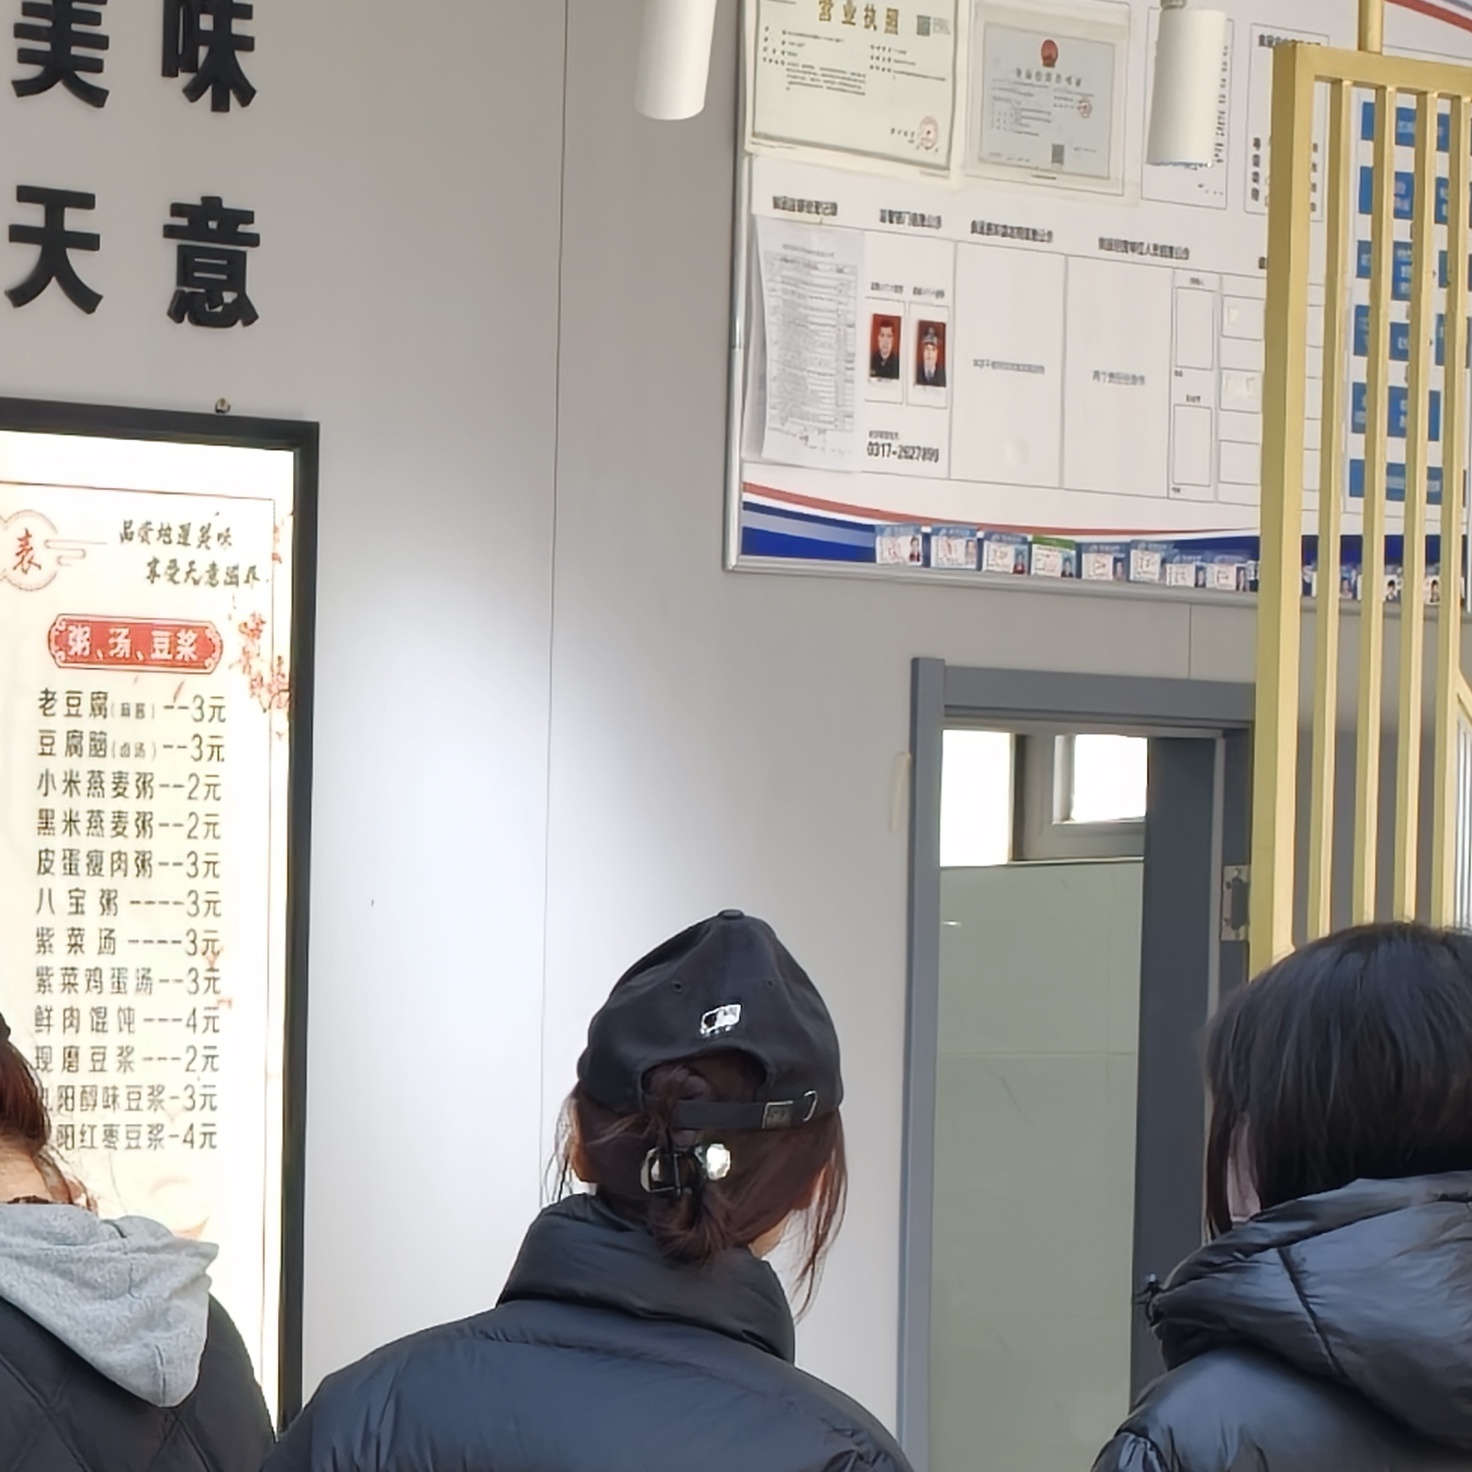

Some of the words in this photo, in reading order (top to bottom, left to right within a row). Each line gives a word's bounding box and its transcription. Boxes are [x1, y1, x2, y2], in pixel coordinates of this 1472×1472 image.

[66, 624, 199, 662] 粥、汤、豆浆
[56, 1123, 217, 1151] 阳红枣豆浆-4元
